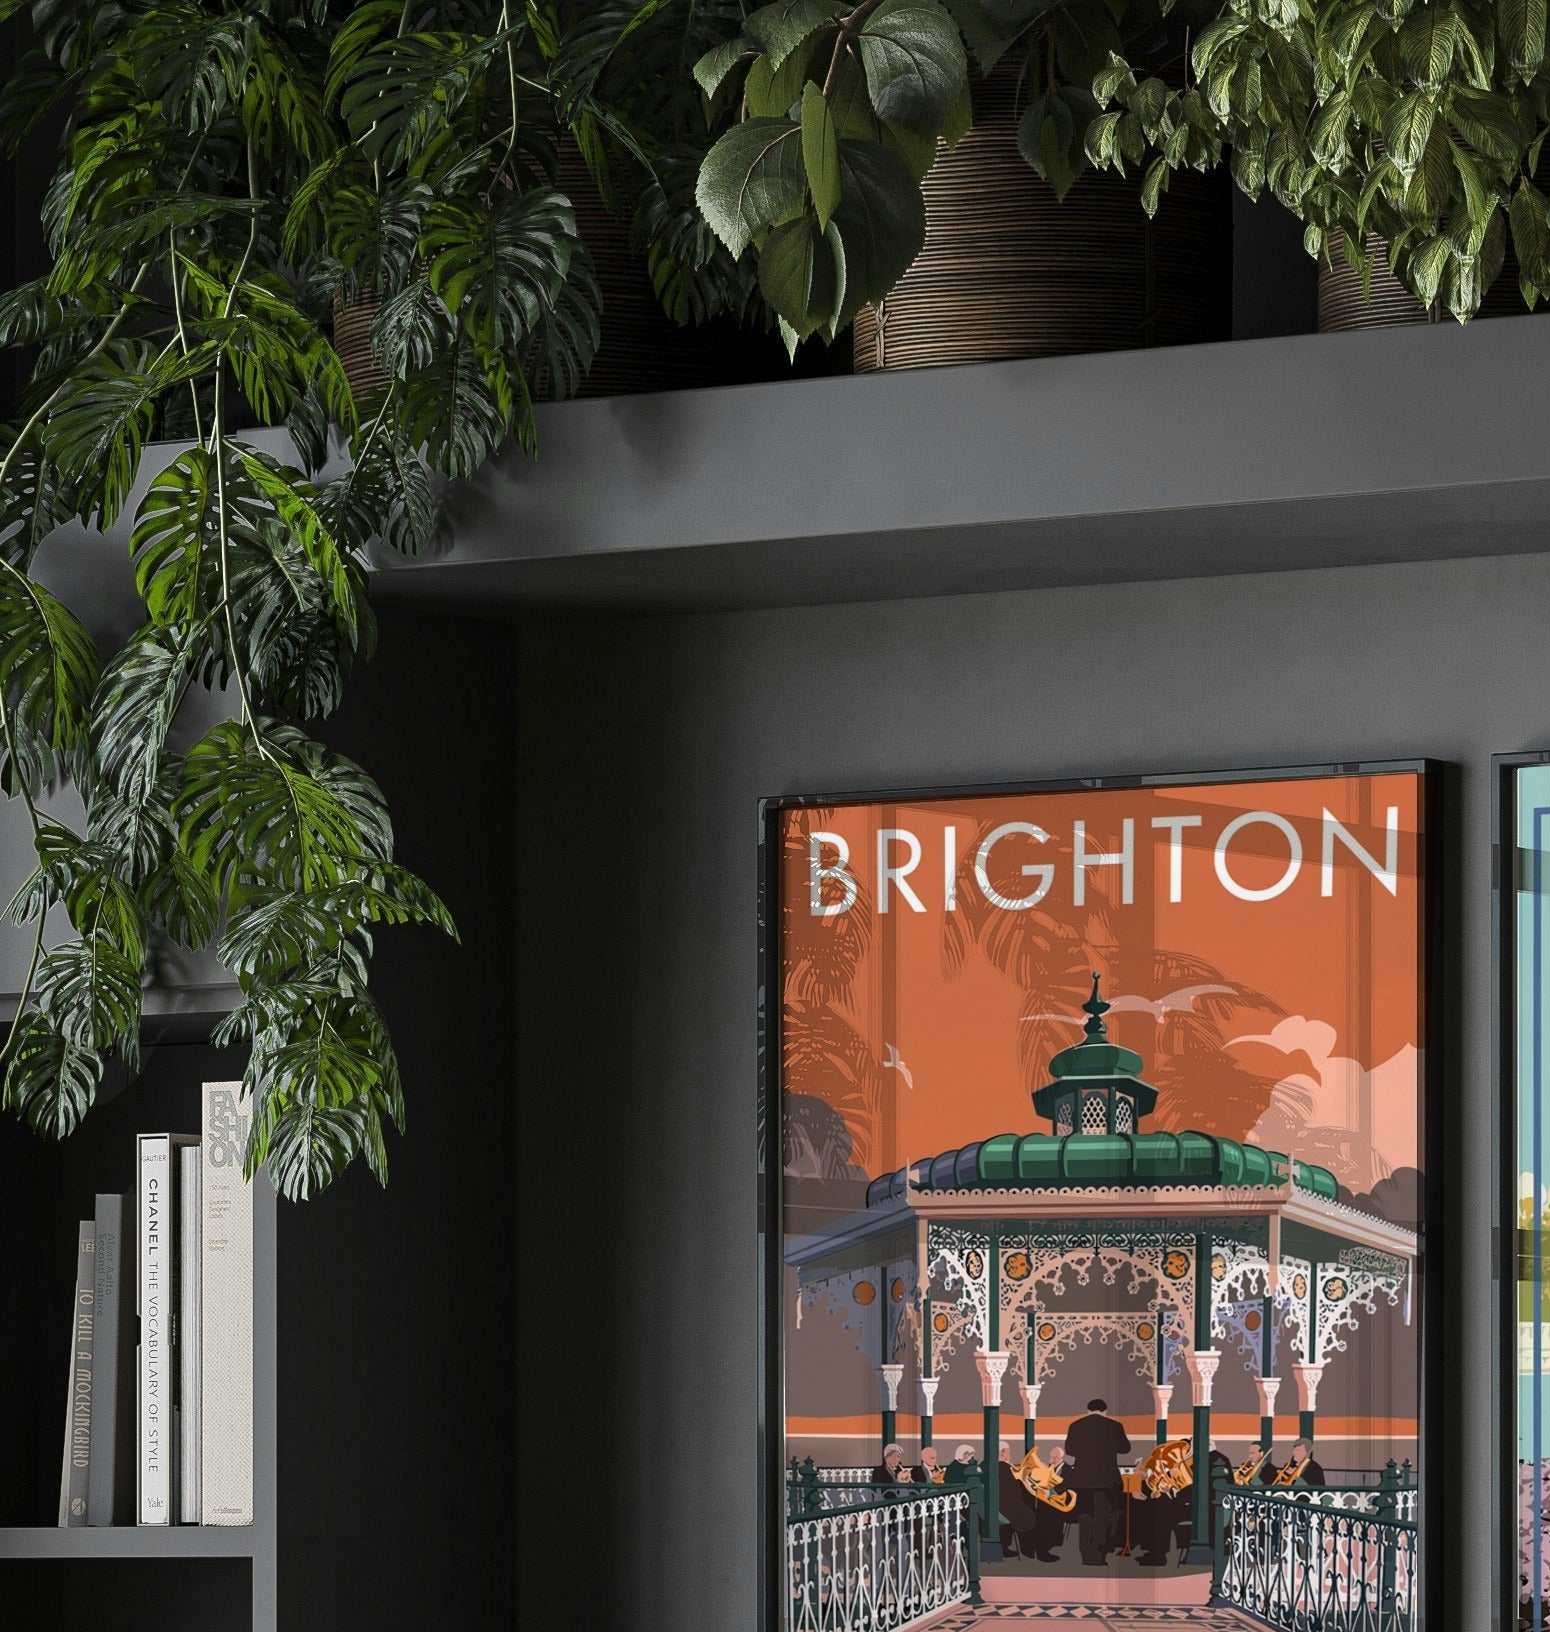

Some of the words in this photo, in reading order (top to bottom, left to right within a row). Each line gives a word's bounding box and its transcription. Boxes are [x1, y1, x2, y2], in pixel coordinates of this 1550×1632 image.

[810, 806, 1399, 917] BRIGHTON
[148, 1178, 158, 1256] CHANEL
[98, 1232, 107, 1274] Second
[106, 1232, 116, 1262] Alvar
[105, 1266, 115, 1296] Aalto
[148, 1262, 158, 1290] THE
[97, 1278, 106, 1317] Nature
[77, 1314, 93, 1343] KILL
[77, 1351, 92, 1360] A
[148, 1295, 158, 1398] VOCABULARY
[73, 1368, 92, 1468] MOCKINGBIRD
[148, 1403, 159, 1423] OF
[148, 1429, 158, 1473] STYLE
[147, 1497, 164, 1508] Yale
